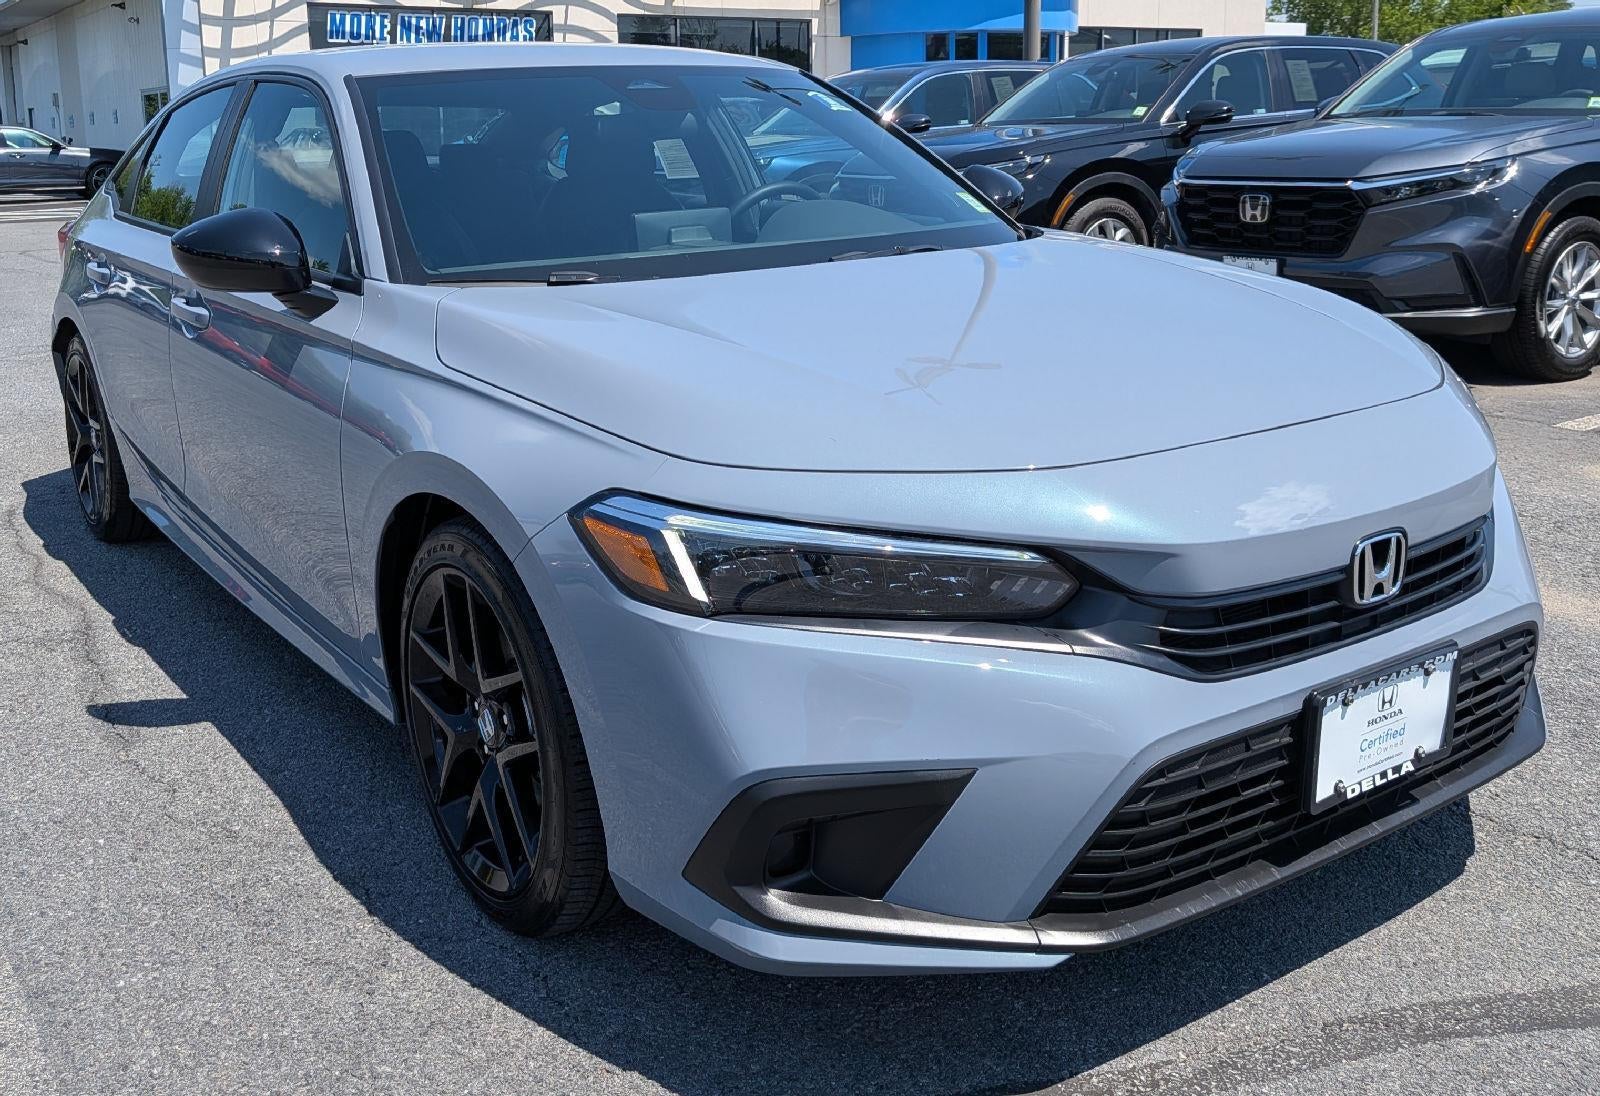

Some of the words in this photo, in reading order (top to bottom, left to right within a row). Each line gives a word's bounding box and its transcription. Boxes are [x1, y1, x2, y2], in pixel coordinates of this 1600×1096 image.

[327, 11, 390, 43] MORE
[397, 14, 446, 43] NEW
[452, 15, 536, 42] HONDAS
[1366, 708, 1404, 728] HONDA
[1358, 740, 1404, 763] Pre-Owned
[1360, 722, 1406, 752] Certified
[1346, 760, 1415, 799] DELLA
